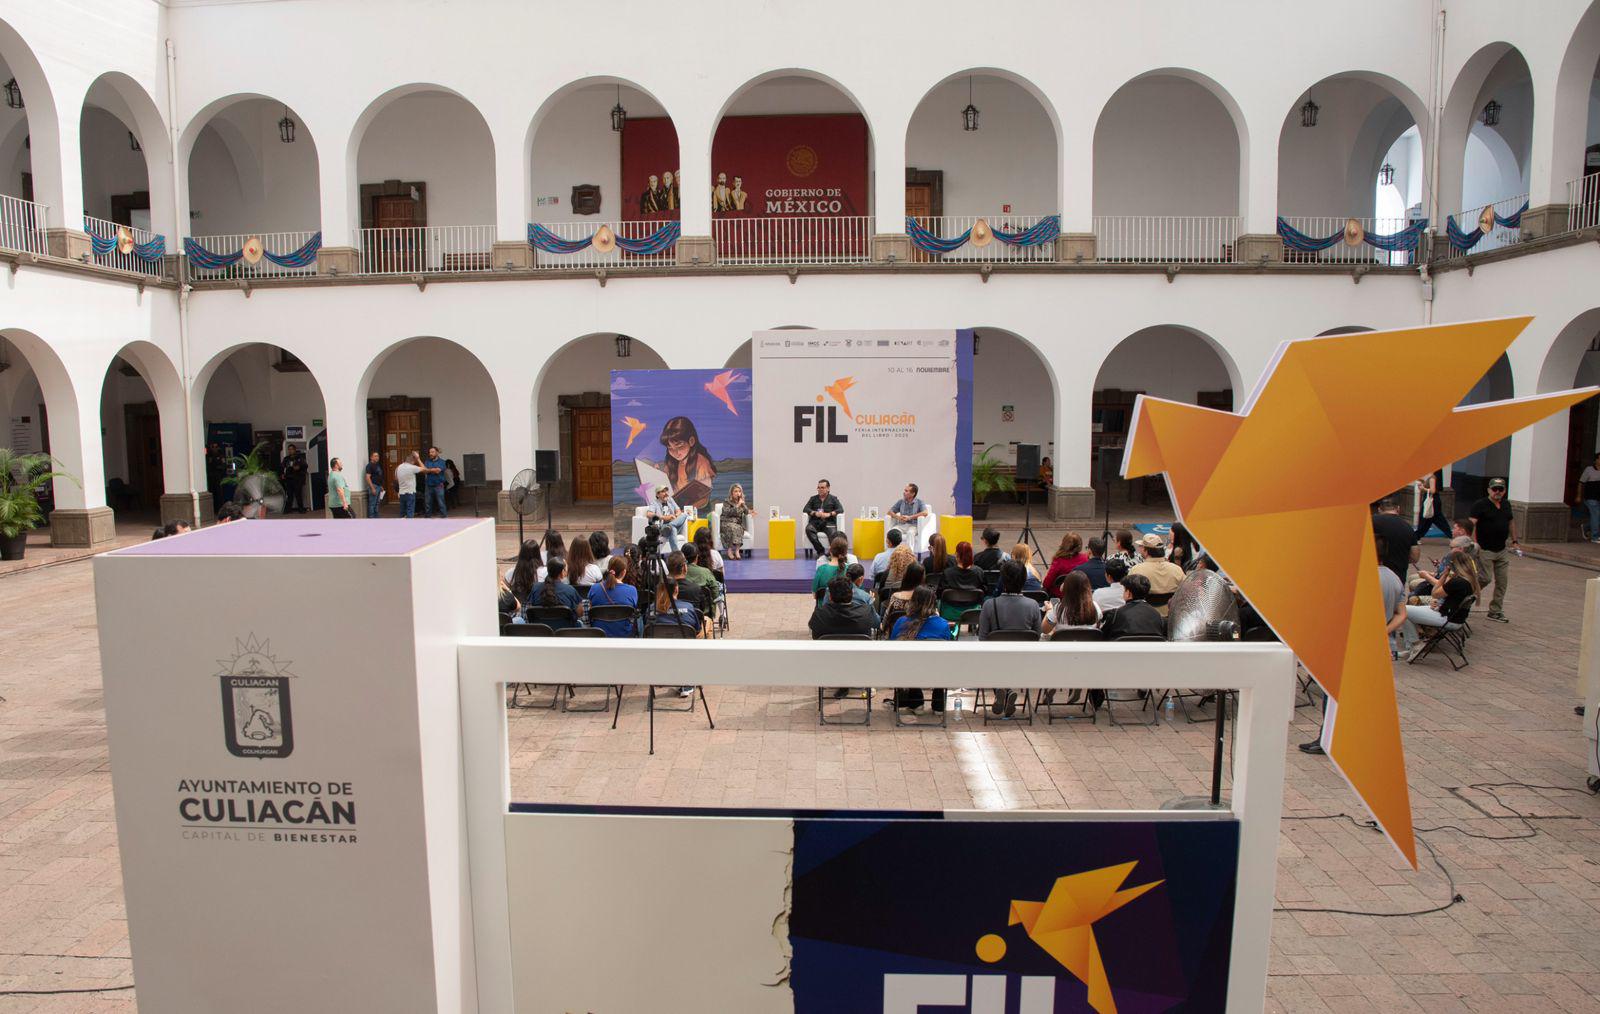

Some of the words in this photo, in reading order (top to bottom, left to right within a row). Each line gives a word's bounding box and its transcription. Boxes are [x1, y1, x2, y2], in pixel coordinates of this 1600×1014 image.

[765, 188, 824, 198] GOBIERNO
[826, 188, 841, 197] DE
[766, 197, 842, 213] MÉXICO
[793, 405, 849, 443] FIL
[230, 679, 280, 687] CULIACAN
[178, 779, 323, 796] AYUNTAMIENTO
[327, 782, 354, 796] DE
[179, 797, 357, 826] CULIACÁN
[182, 830, 242, 842] CAPITAL
[247, 832, 266, 842] DE
[274, 833, 358, 844] BIENESTAR
